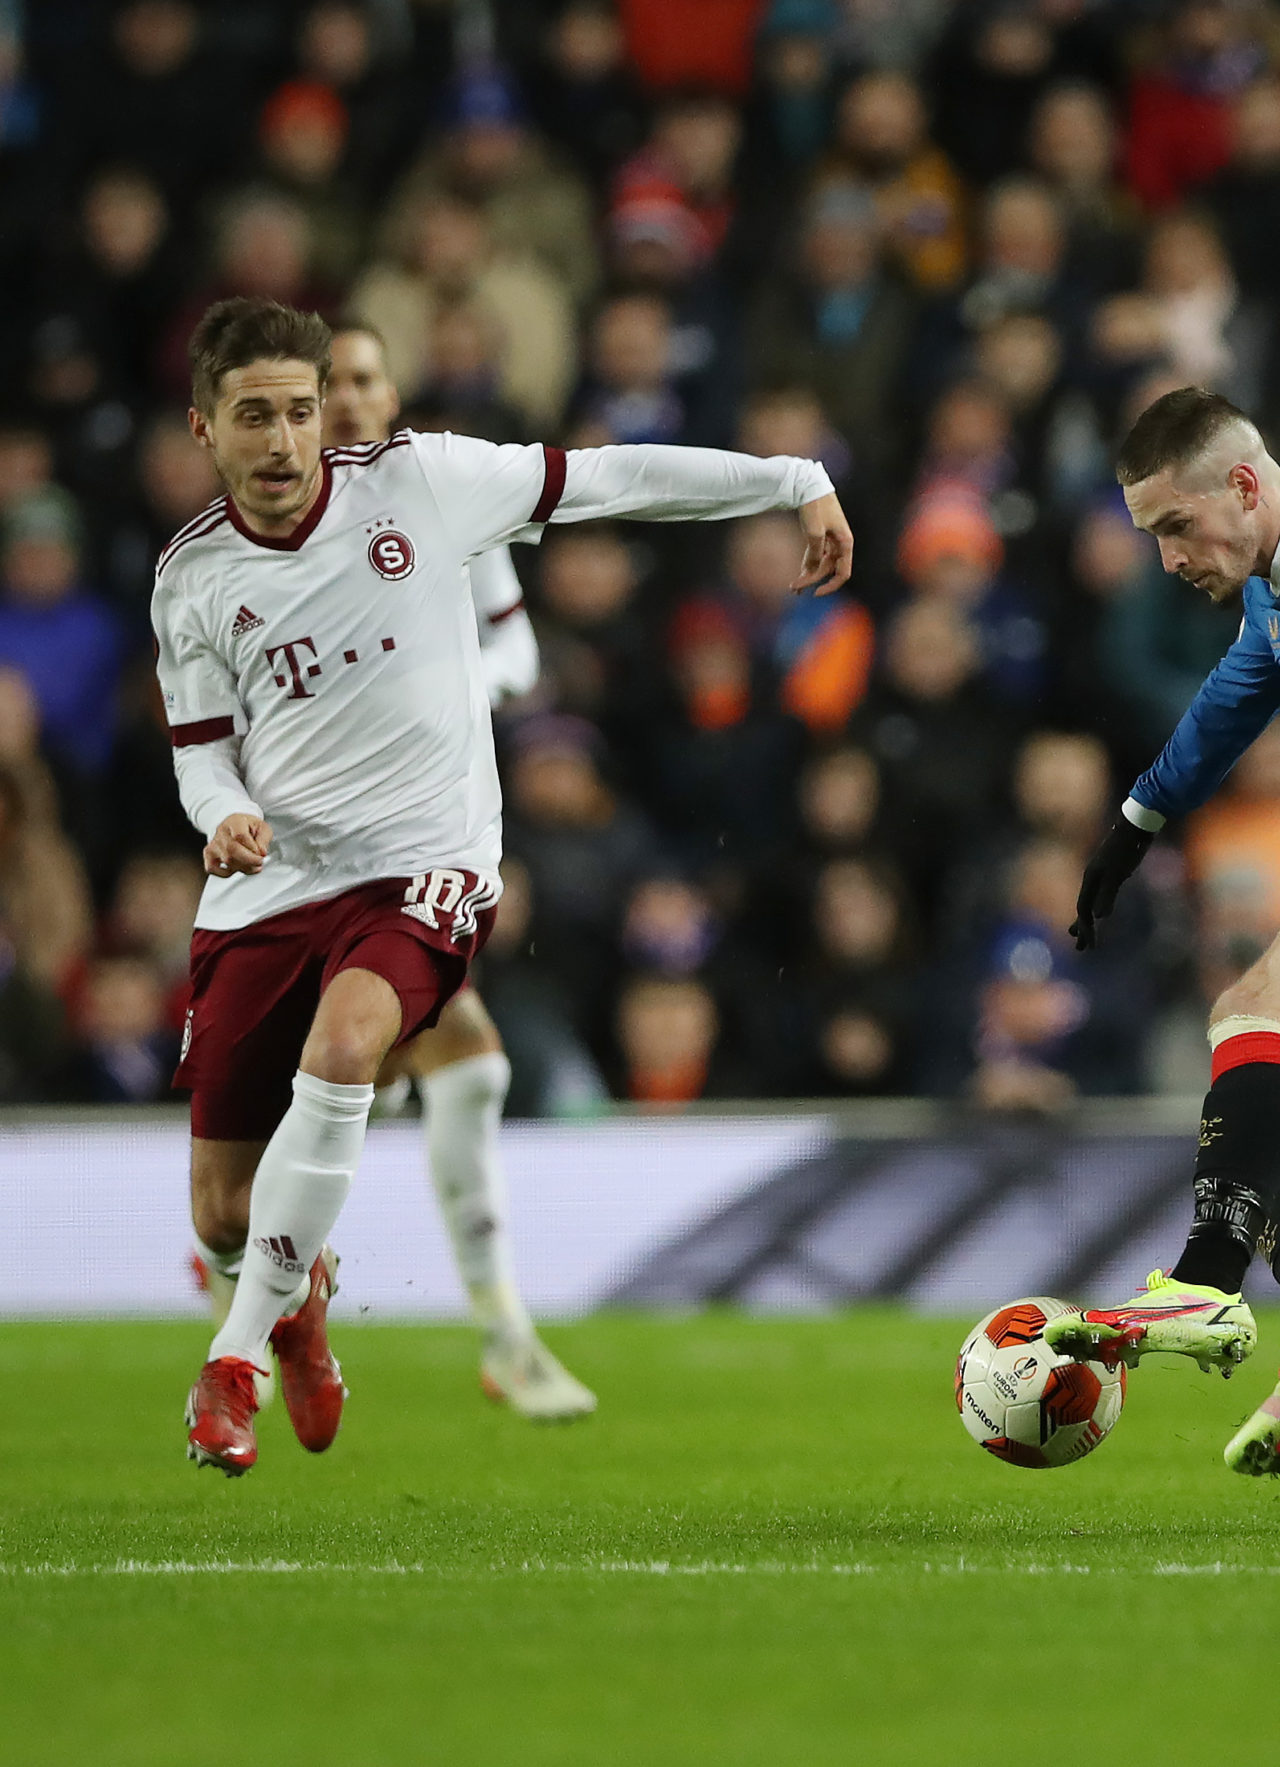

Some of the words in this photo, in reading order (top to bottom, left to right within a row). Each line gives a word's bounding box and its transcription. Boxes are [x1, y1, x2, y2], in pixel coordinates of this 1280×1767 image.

[379, 539, 405, 569] S
[253, 1238, 305, 1273] adidas
[993, 1371, 1018, 1401] EUROPA
[965, 1392, 1001, 1435] molten
